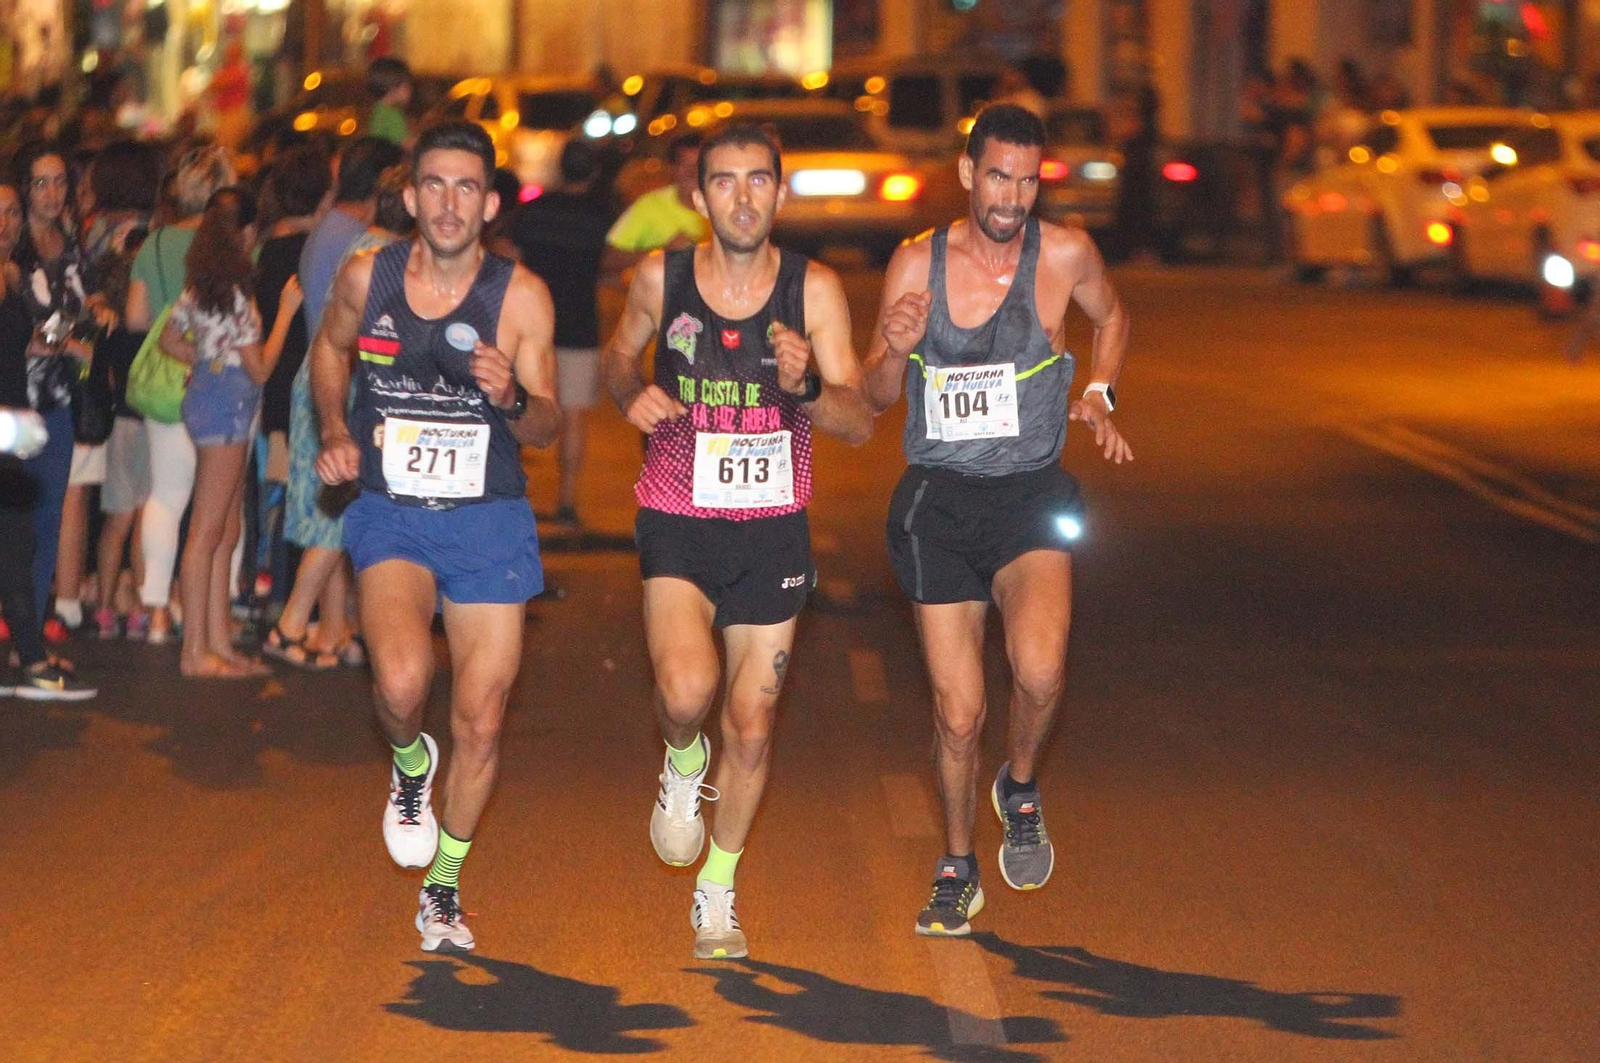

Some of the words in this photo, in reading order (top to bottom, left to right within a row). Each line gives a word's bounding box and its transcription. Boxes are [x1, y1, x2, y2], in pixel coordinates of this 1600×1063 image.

[947, 369, 1004, 382] NOCTURNA
[677, 375, 696, 402] TRI
[701, 378, 740, 406] COSTA
[745, 383, 761, 406] DE
[944, 381, 959, 392] DE
[962, 379, 1002, 391] HUELVA
[939, 391, 989, 418] 104
[420, 427, 478, 438] NOCTURNA
[434, 437, 474, 448] HUELVA
[731, 435, 783, 447] NOCTURNA
[746, 446, 782, 457] HUELVA
[406, 446, 456, 474] 271
[719, 457, 769, 484] 613
